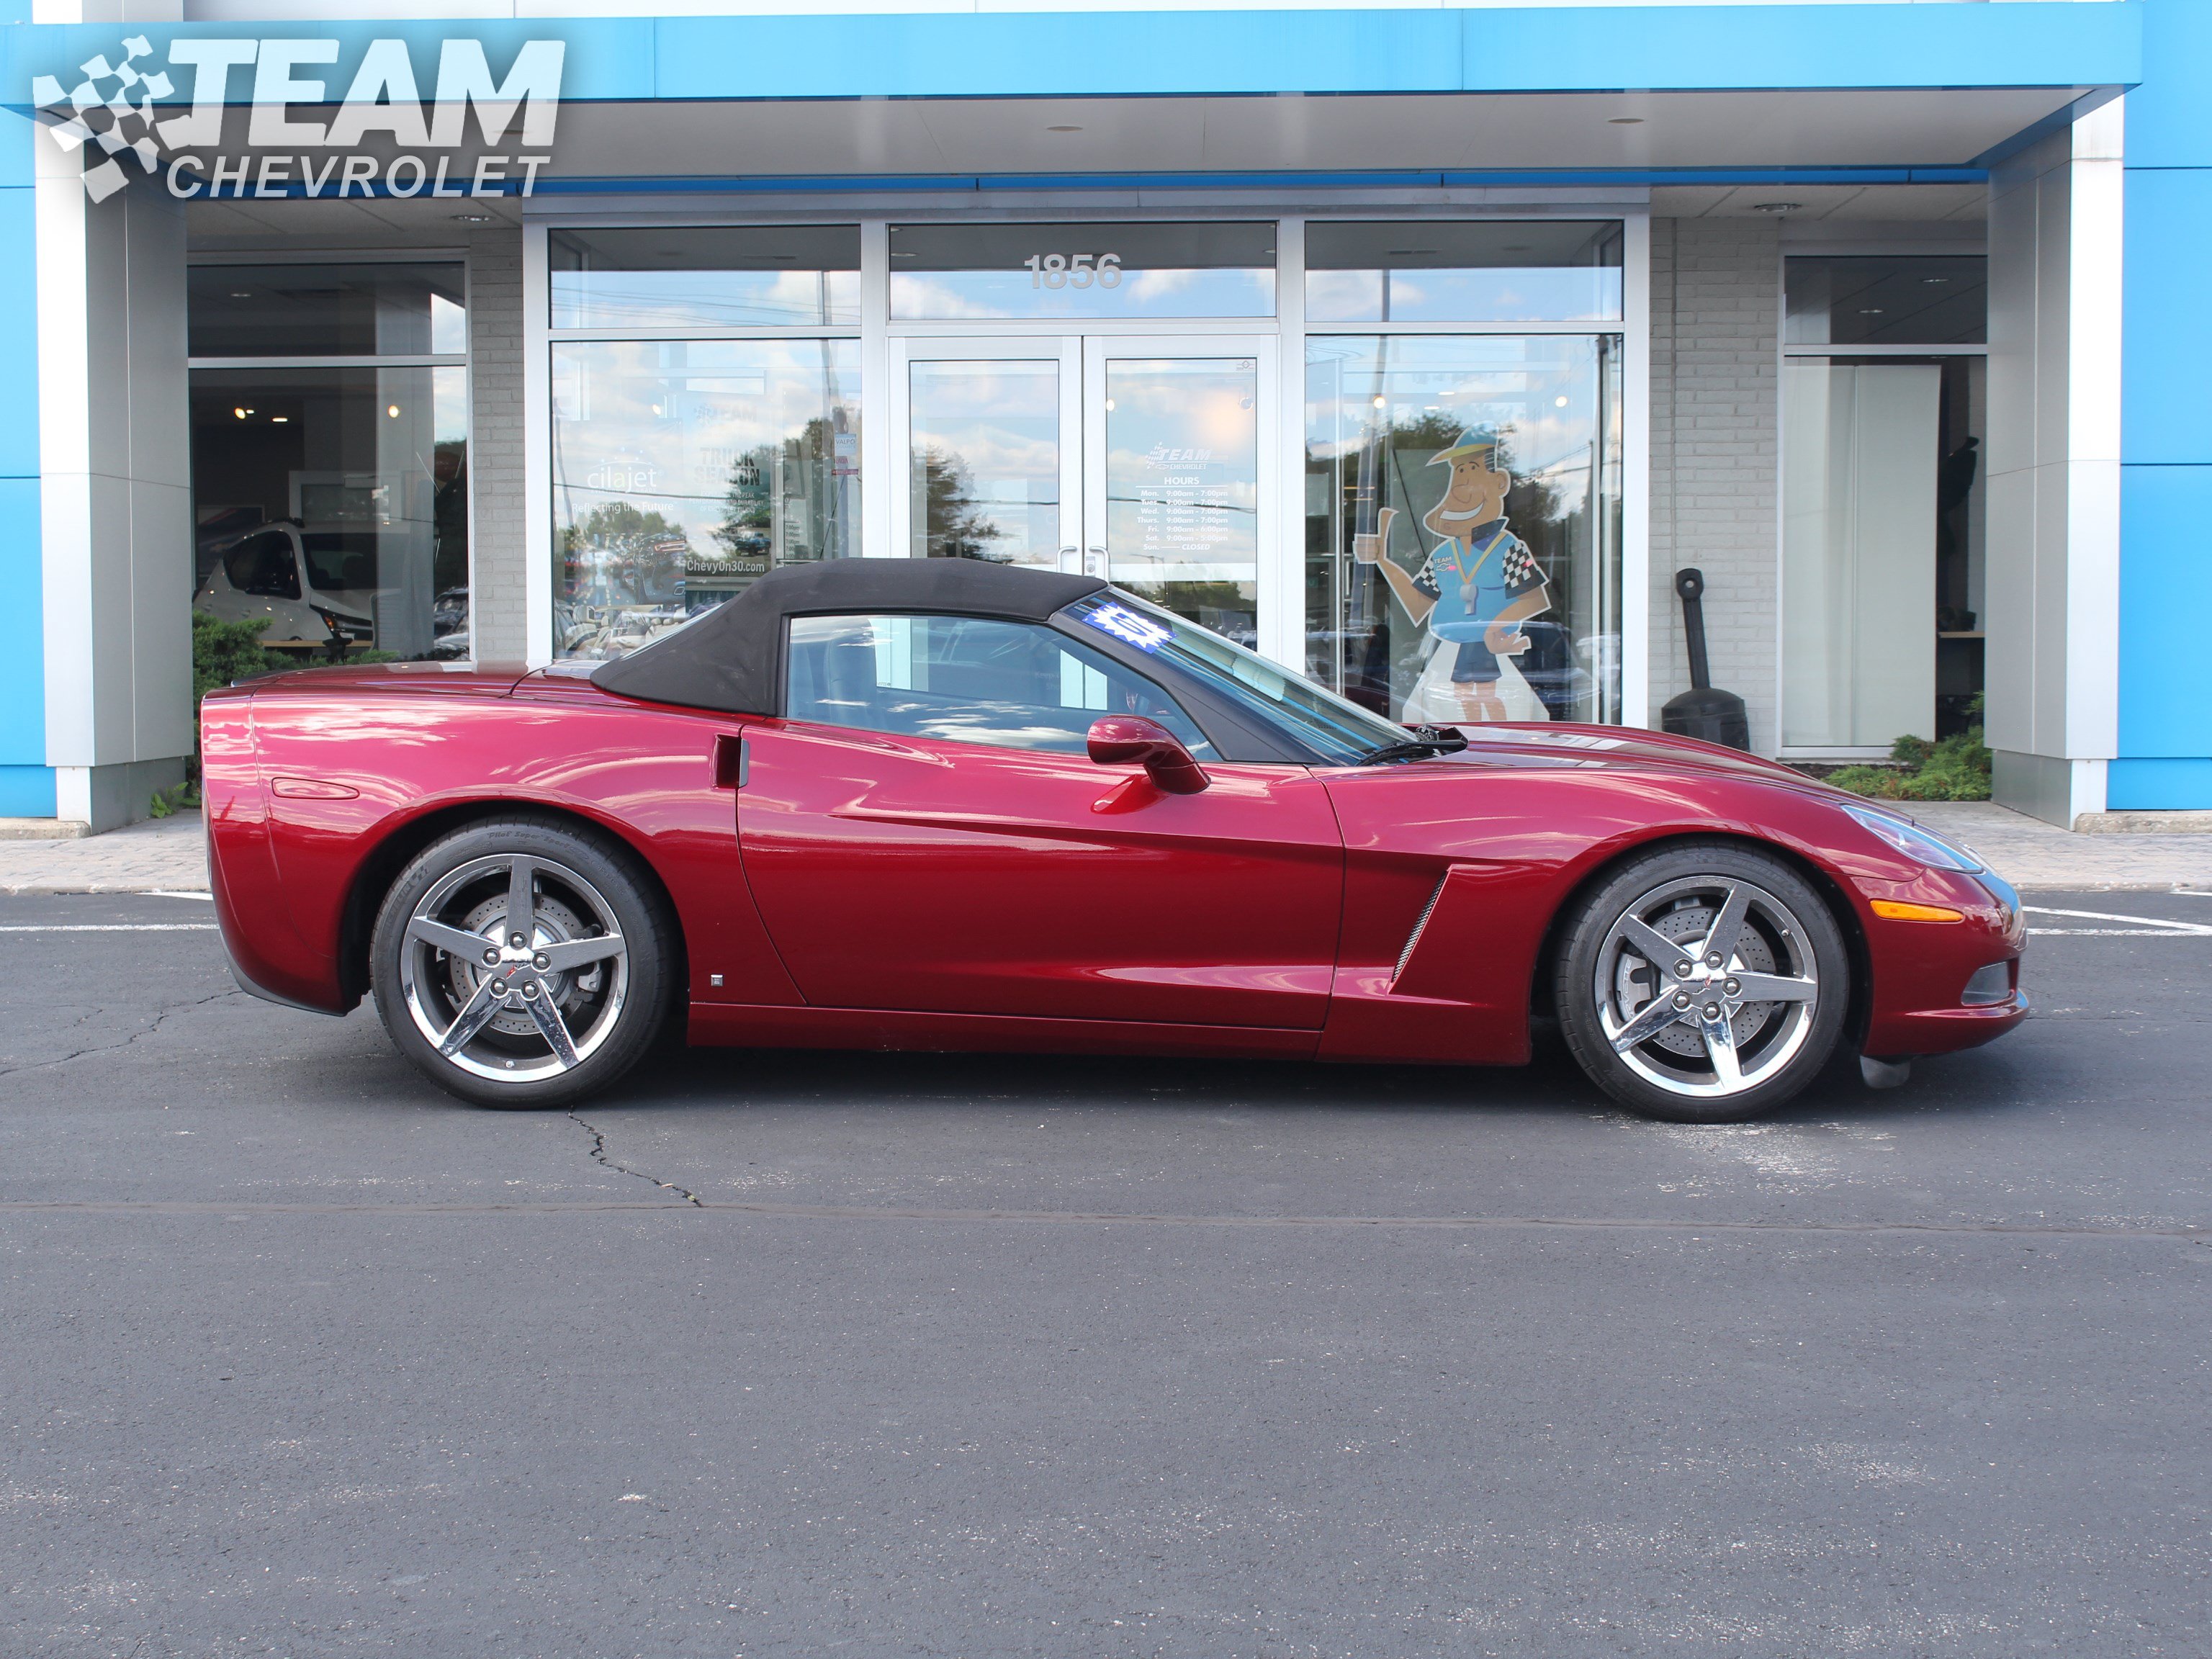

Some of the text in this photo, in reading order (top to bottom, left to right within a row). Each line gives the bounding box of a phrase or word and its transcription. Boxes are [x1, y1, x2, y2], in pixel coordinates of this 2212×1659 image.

[1024, 253, 1122, 289] 1856
[1159, 449, 1211, 460] TEAM
[587, 467, 657, 493] cilajet
[572, 502, 674, 514] Reflecting the Future
[687, 559, 765, 574] ChevyOn30.com
[514, 831, 541, 840] Super
[544, 836, 570, 848] Sport
